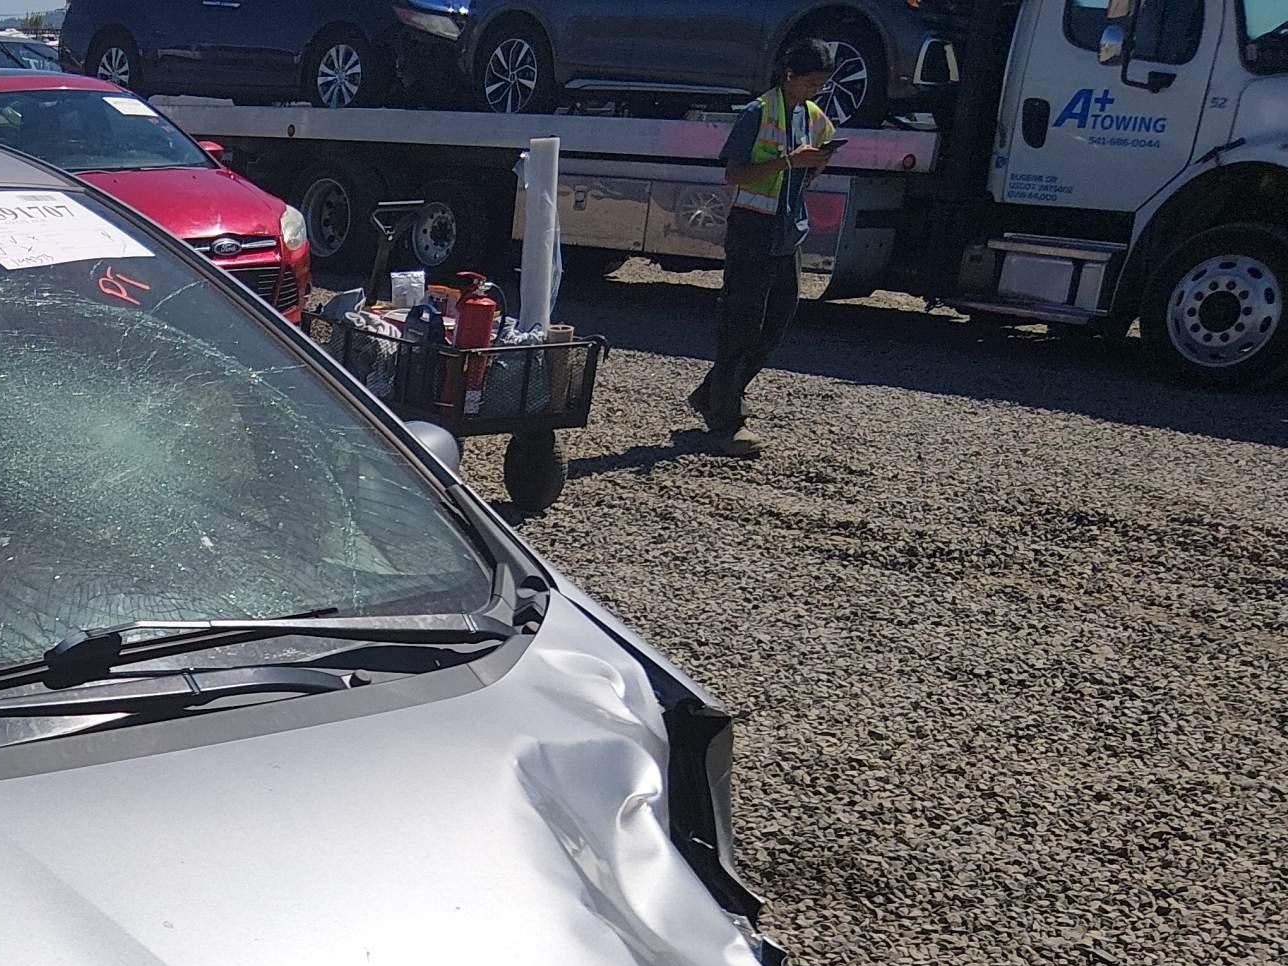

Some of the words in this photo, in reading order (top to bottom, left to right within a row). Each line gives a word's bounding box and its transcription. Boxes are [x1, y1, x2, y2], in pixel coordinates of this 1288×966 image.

[1053, 89, 1114, 129] A+
[1209, 96, 1228, 109] 52
[1090, 114, 1167, 133] TOWING
